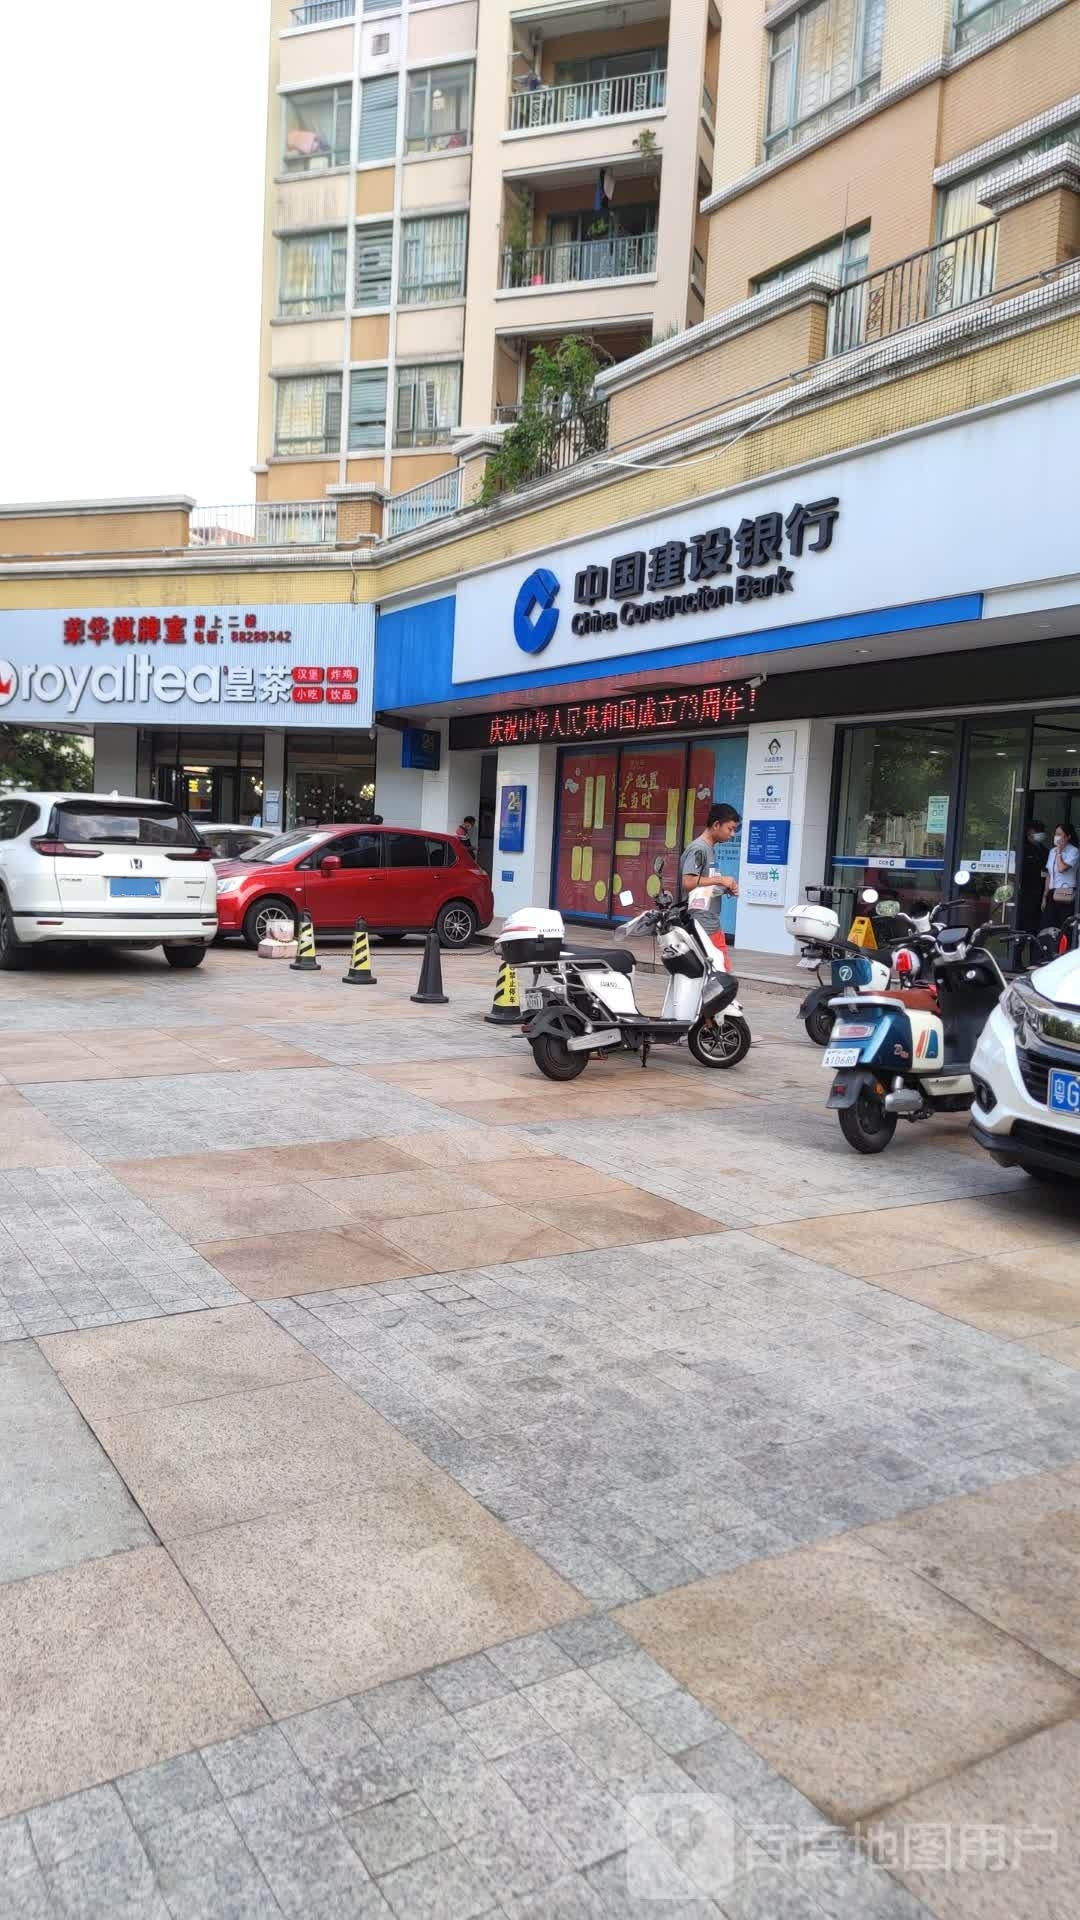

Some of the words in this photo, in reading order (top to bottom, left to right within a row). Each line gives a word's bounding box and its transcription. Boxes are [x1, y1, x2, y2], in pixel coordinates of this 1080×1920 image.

[574, 496, 840, 606] 中国建设银行
[571, 609, 618, 636] China
[620, 584, 734, 626] Construction
[734, 565, 794, 603] Bank
[63, 615, 188, 646] 荣华棋牌室
[21, 653, 223, 714] royaltea
[224, 664, 293, 704] 皇茶
[296, 687, 319, 700] 小吃
[330, 688, 353, 700] 饮品
